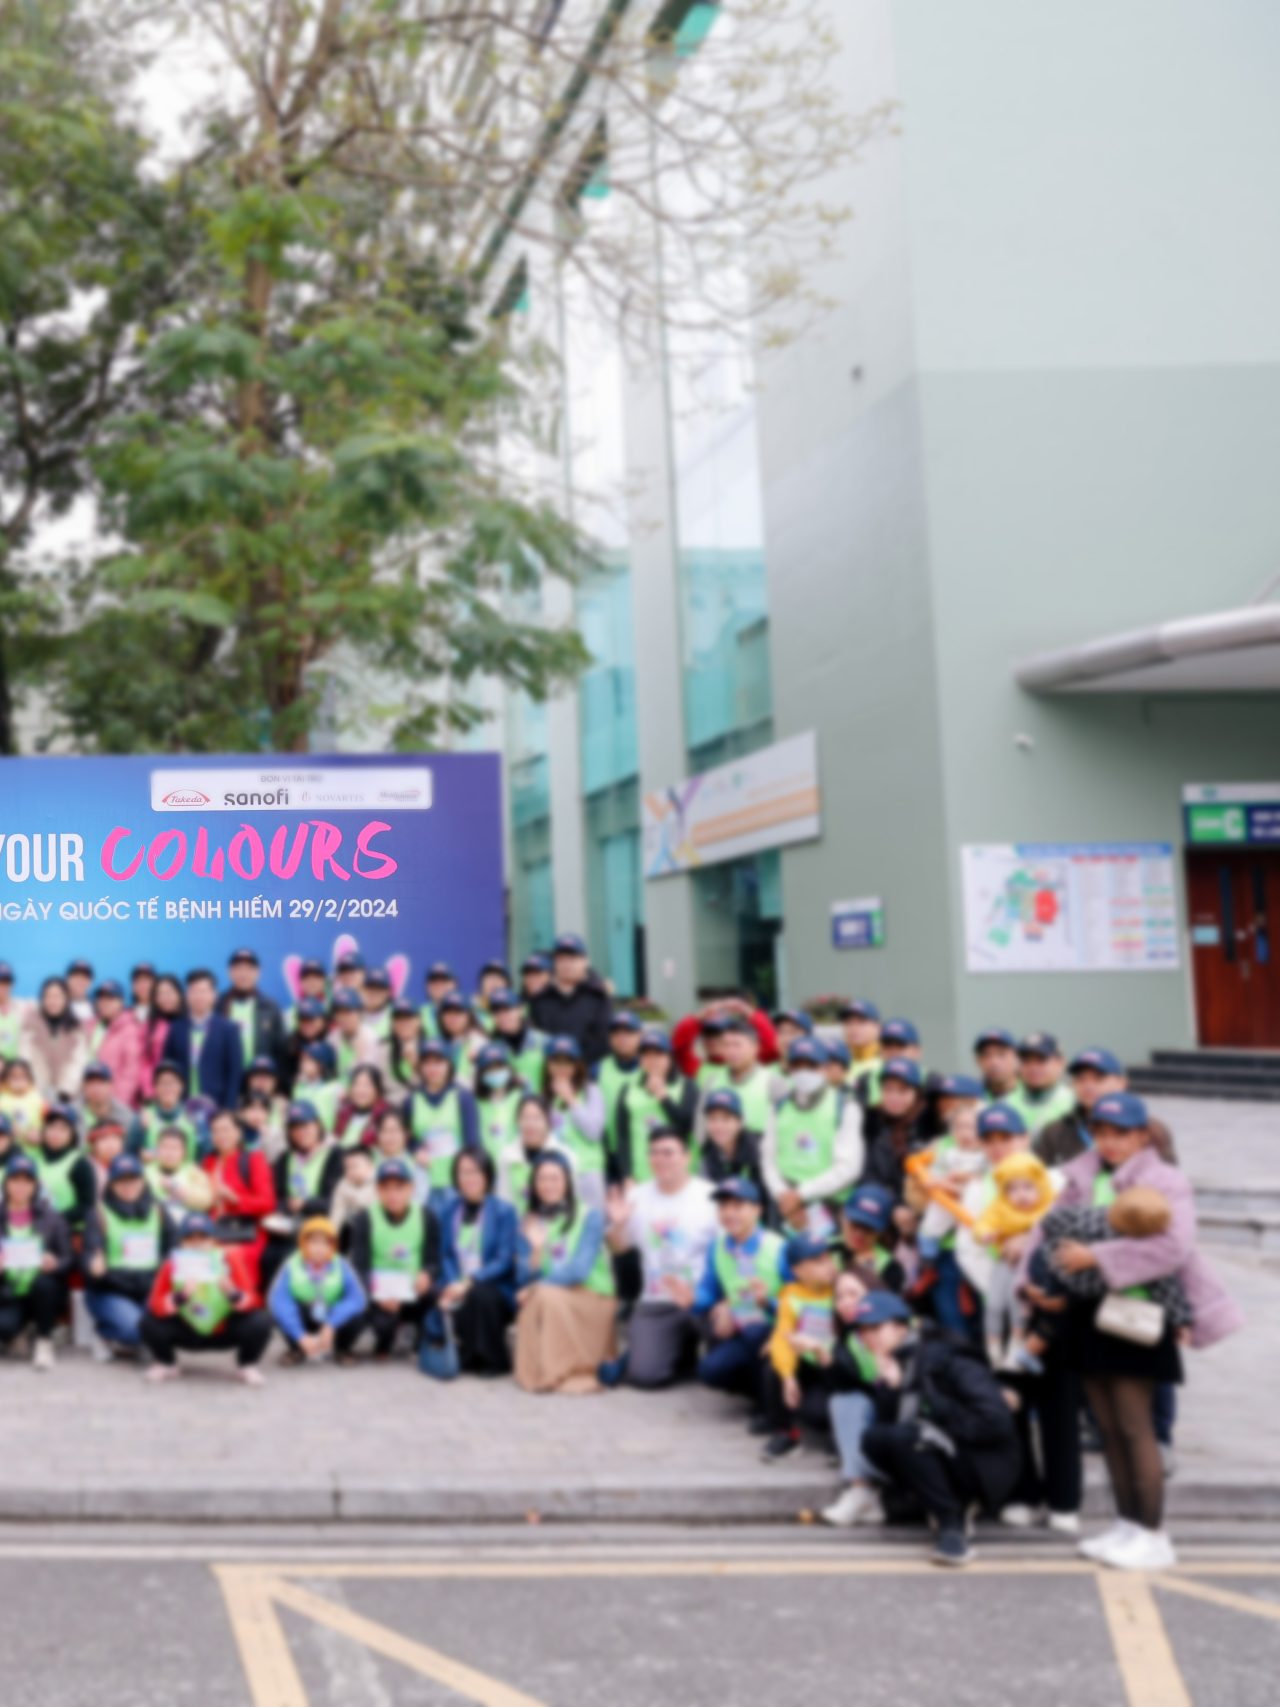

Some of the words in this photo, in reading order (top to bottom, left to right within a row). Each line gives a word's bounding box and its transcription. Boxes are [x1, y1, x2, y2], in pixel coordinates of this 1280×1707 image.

[170, 795, 203, 804] Takeda
[224, 788, 289, 806] sanofi
[100, 820, 398, 882] COLOURS
[58, 895, 130, 920] QUỐC
[136, 895, 159, 920] TẾ
[165, 897, 222, 923] BỆNH
[229, 894, 283, 919] HIẾM
[288, 899, 399, 923] 29/2/2024
